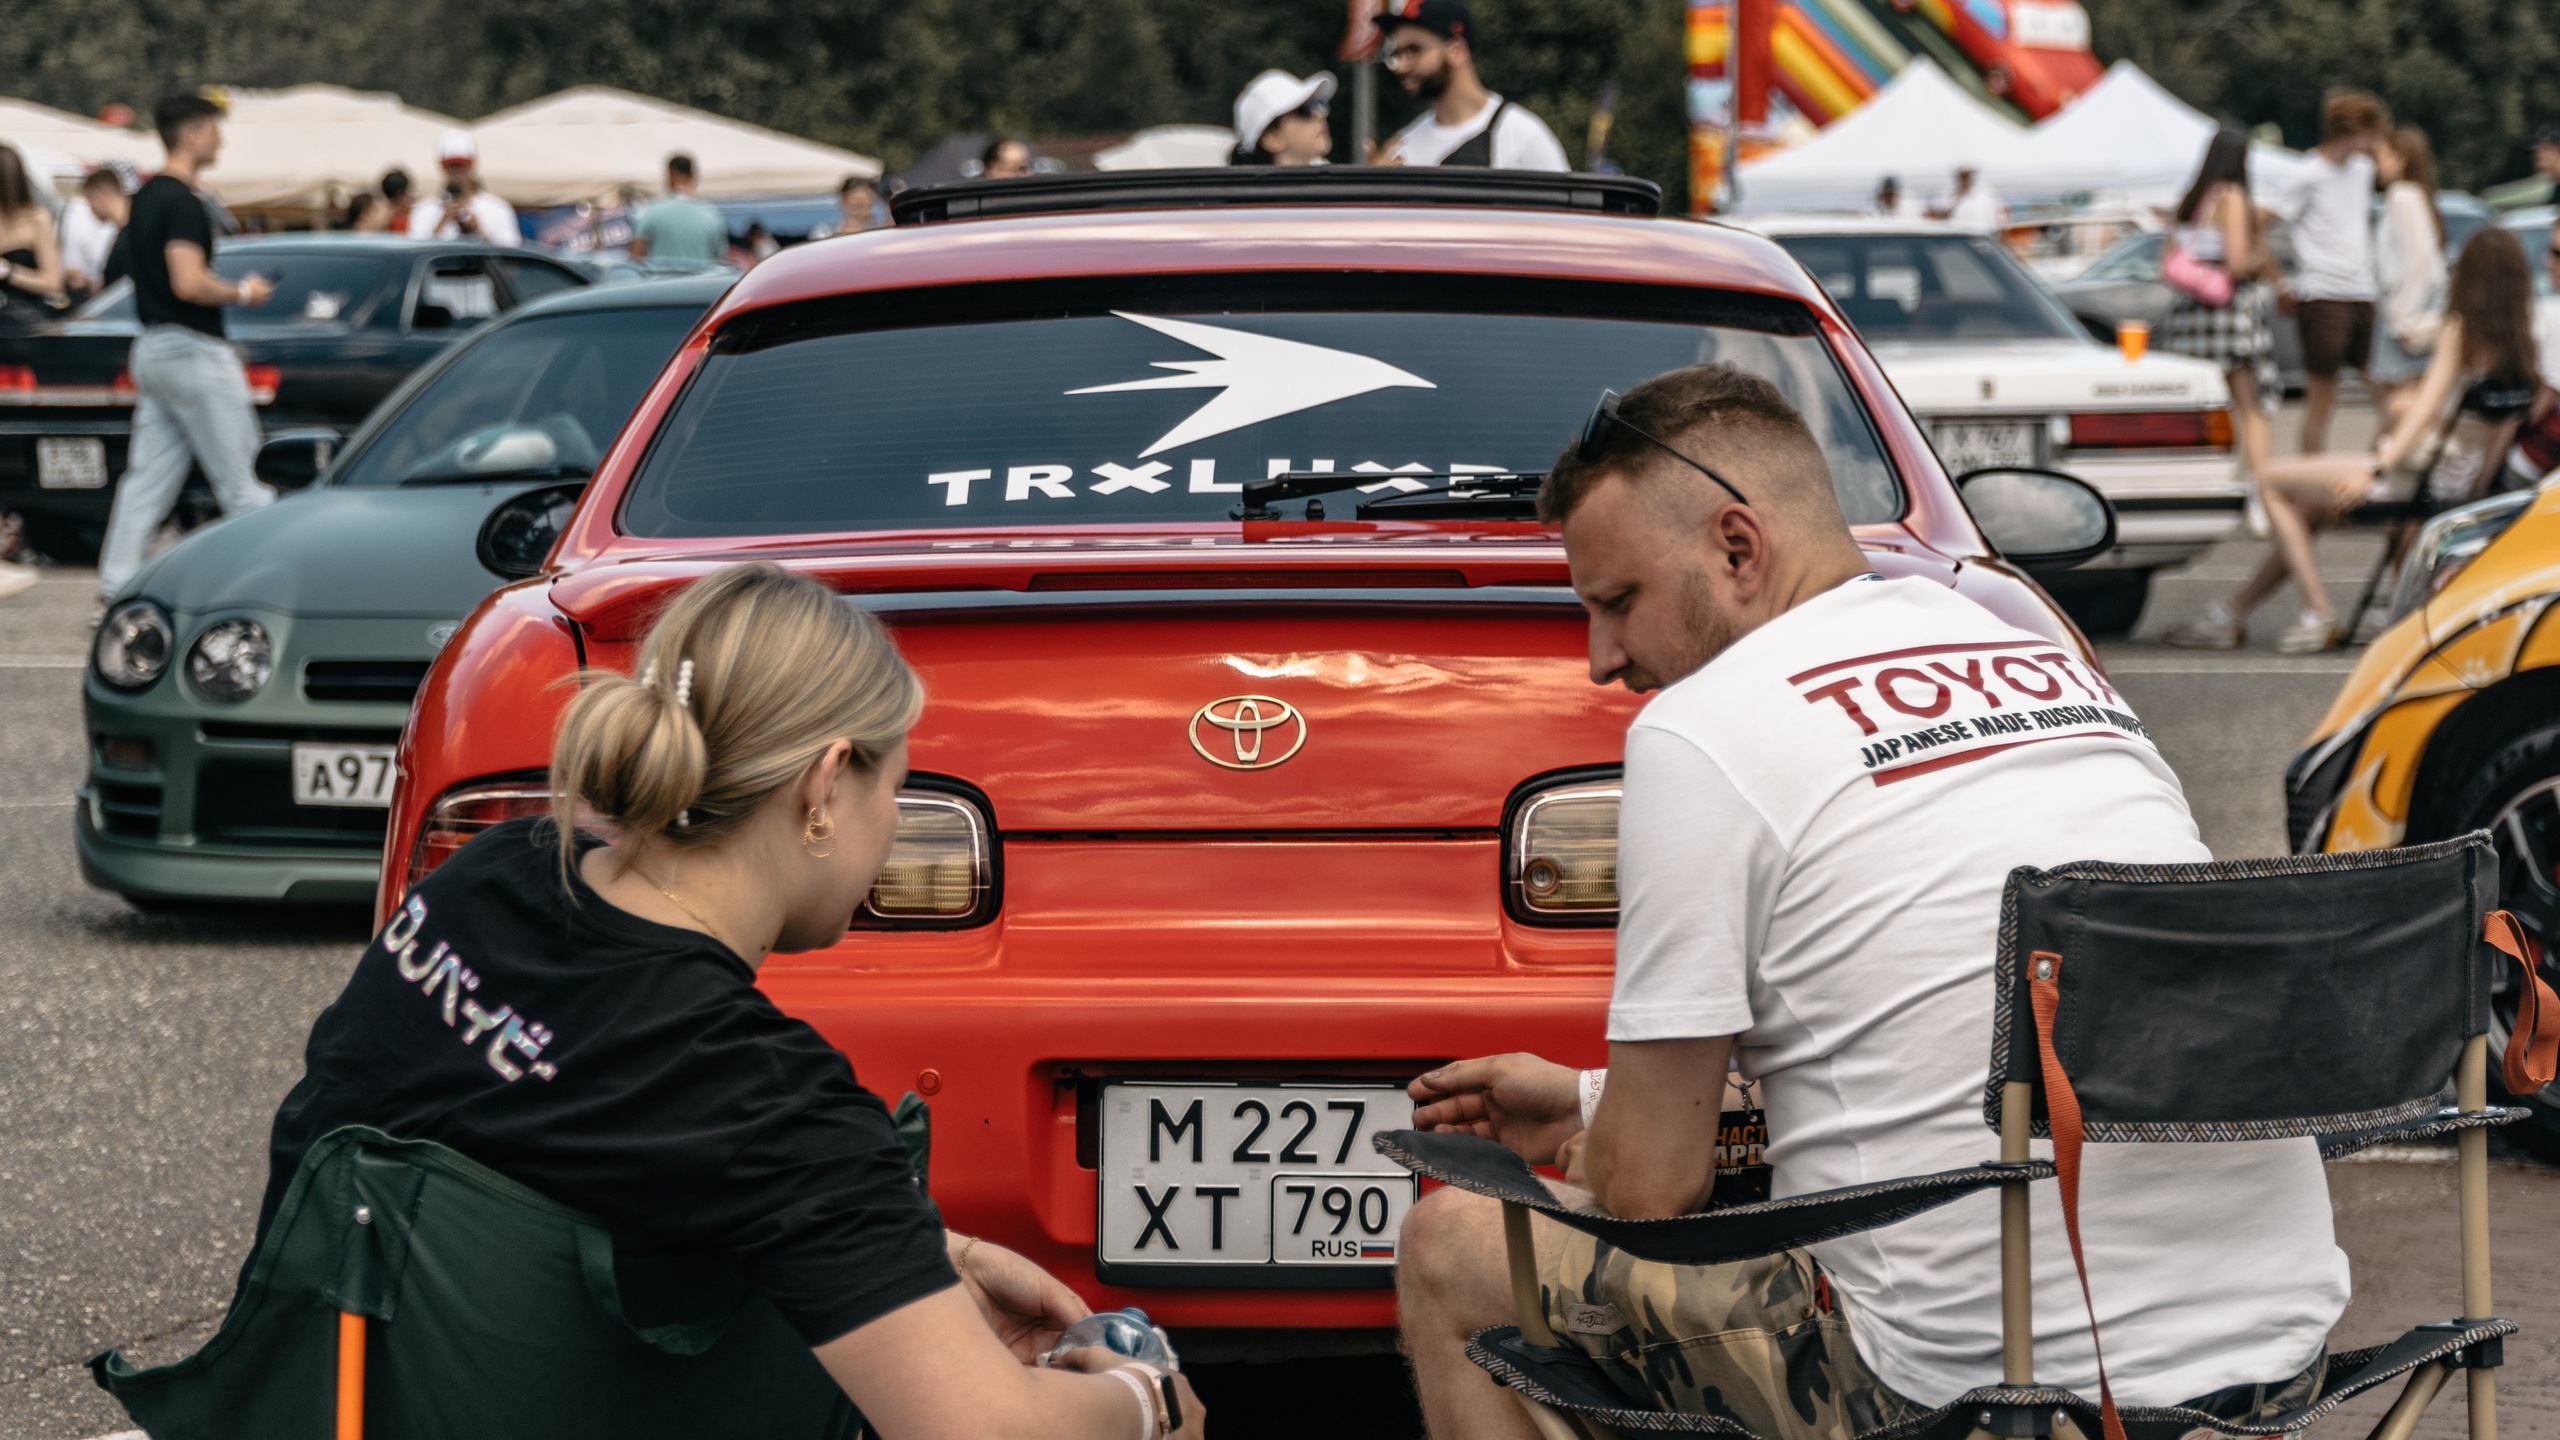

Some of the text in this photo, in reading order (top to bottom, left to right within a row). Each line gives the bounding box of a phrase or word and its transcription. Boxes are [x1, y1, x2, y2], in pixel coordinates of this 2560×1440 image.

[1803, 652, 2119, 737] TOYOTA
[1860, 720, 1974, 768] JAPANESE
[1969, 712, 2034, 737] MADE
[2027, 705, 2107, 730] RUSSIAN
[1150, 1098, 1367, 1165] M 227
[1133, 1184, 1390, 1250] XT 790
[1311, 1240, 1358, 1258] RUS
